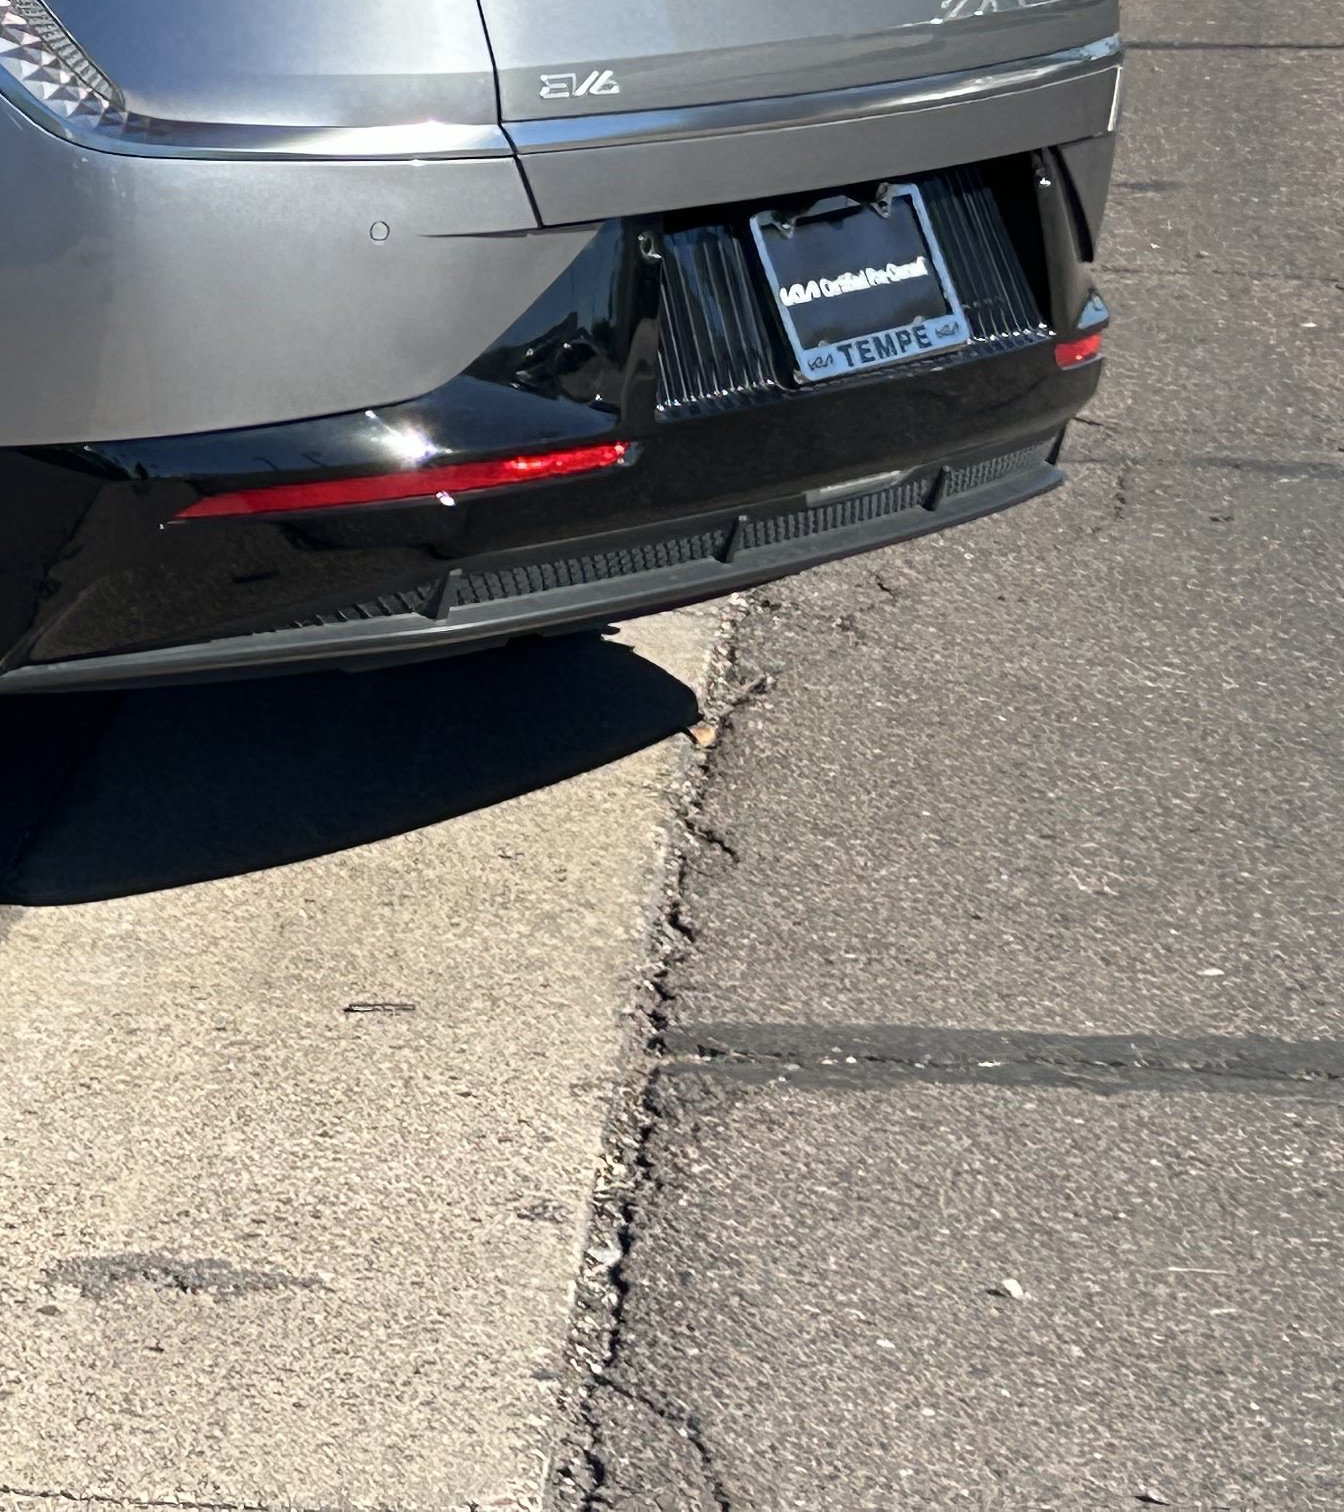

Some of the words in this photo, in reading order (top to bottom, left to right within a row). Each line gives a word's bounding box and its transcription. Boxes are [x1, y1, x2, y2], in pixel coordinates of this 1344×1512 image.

[539, 69, 620, 99] EV6
[779, 280, 821, 307] KIA
[836, 324, 933, 368] TEMPE
